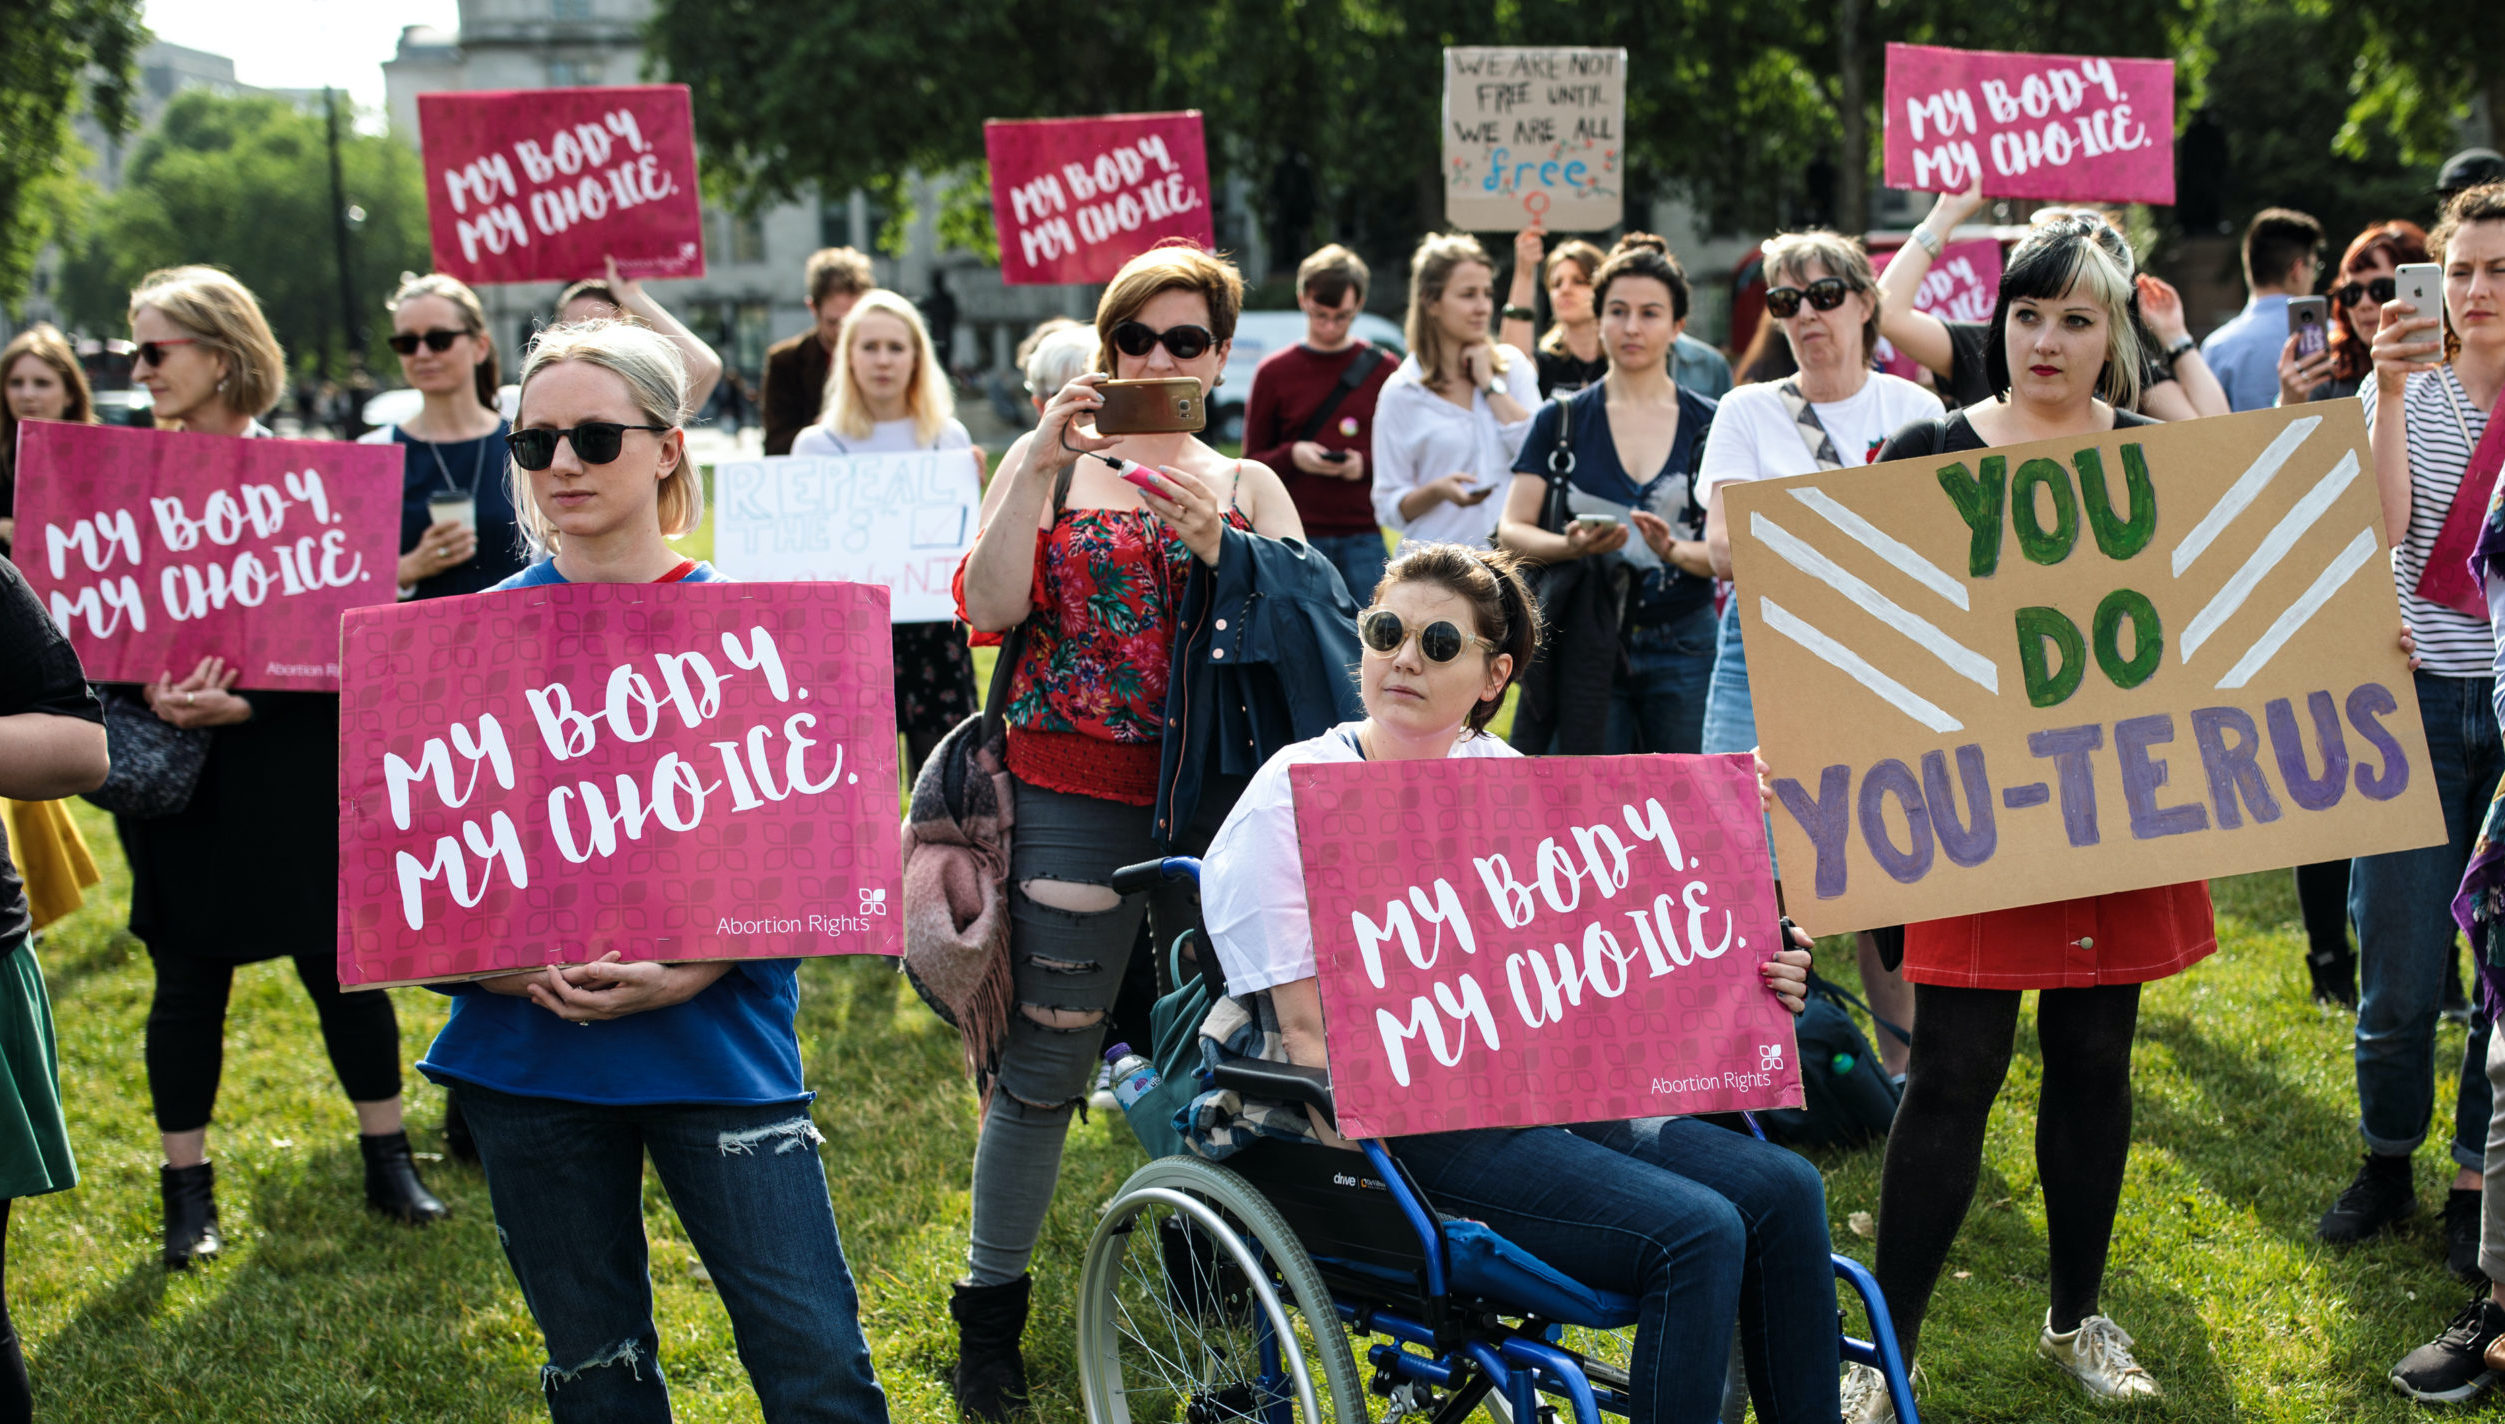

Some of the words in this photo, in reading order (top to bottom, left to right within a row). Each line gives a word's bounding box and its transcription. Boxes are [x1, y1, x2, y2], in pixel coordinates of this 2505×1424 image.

[1453, 54, 1501, 76] WE
[1508, 53, 1561, 79] ARE
[1568, 53, 1616, 76] NOT
[1476, 82, 1531, 114] FREE
[1547, 84, 1610, 108] UNTIL
[1906, 88, 1977, 141] MY
[1980, 58, 2129, 124] BODY.
[444, 153, 517, 214] MY
[514, 109, 653, 184] BODY.
[1453, 120, 1501, 144] WE
[1513, 118, 1556, 145] ARE
[1572, 116, 1615, 140] ALL
[1482, 147, 1588, 192] free
[1912, 140, 1982, 189] MY
[1990, 104, 2153, 177] CHOICE.
[456, 203, 529, 264] MY
[530, 154, 679, 235] CHOICE.
[1010, 174, 1067, 225] MY
[1062, 135, 1179, 201] BODY.
[1019, 217, 1077, 267] MY
[1076, 173, 1202, 244] CHOICE.
[45, 508, 142, 580] MY
[150, 468, 342, 552] BODY.
[723, 455, 958, 520] REPEAL
[1936, 442, 2158, 578] YOU
[726, 516, 830, 556] THE
[50, 575, 147, 640] MY
[160, 528, 371, 622] CHOICE.
[2014, 588, 2163, 708] DO
[383, 712, 516, 831] MY
[524, 625, 810, 761] BODY.
[395, 810, 529, 931] MY
[547, 712, 859, 864] CHOICE.
[1771, 682, 2410, 900] YOU-TERUS
[716, 917, 802, 935] Abortion
[808, 914, 870, 937] Rights
[1351, 877, 1477, 989] MY
[1472, 797, 1700, 930] BODY.
[1375, 973, 1501, 1088] MY
[1505, 880, 1747, 1029] CHOICE.
[1651, 1074, 1720, 1095] Abortion
[1723, 1071, 1771, 1093] Rights
[1333, 1171, 1356, 1187] drive
